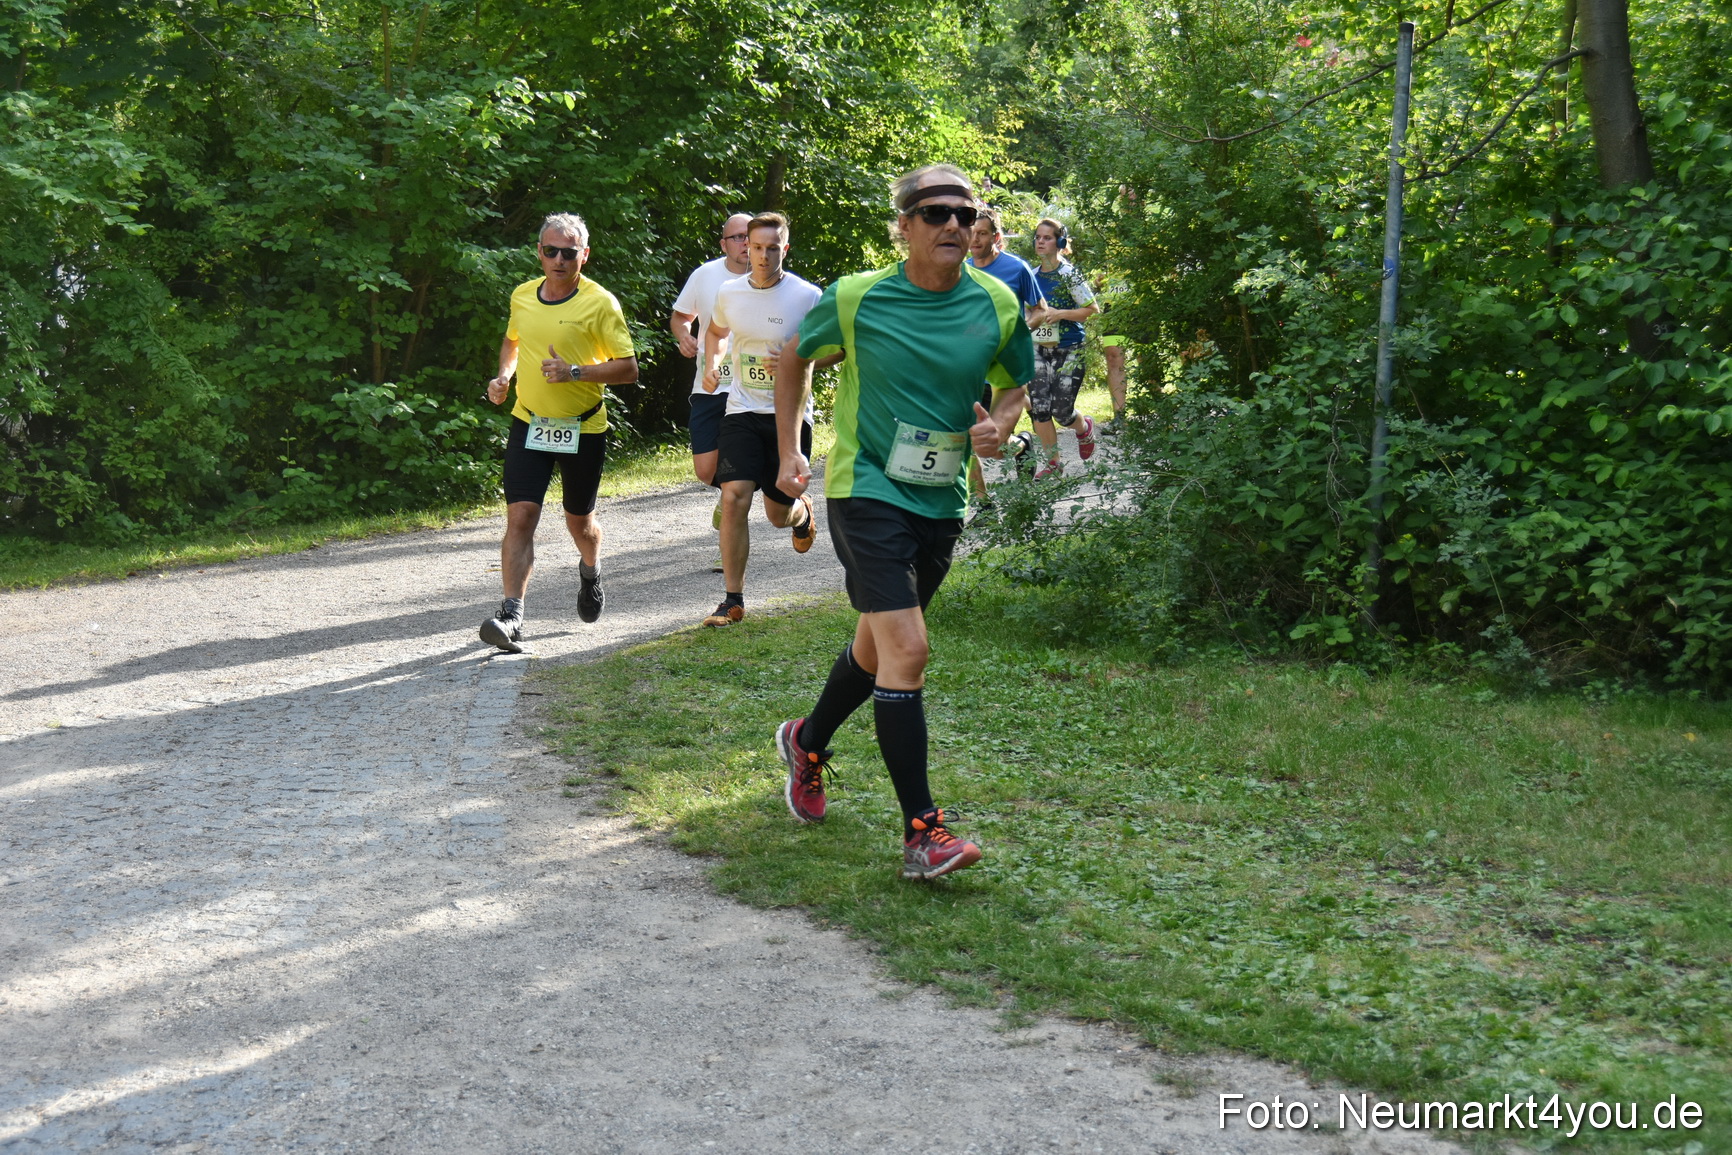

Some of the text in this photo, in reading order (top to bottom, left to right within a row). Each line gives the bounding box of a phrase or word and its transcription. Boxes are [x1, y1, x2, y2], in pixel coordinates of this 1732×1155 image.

[1036, 327, 1052, 337] 236
[533, 427, 572, 443] 2199
[922, 451, 938, 470] 5
[899, 466, 932, 476] Eichenseer
